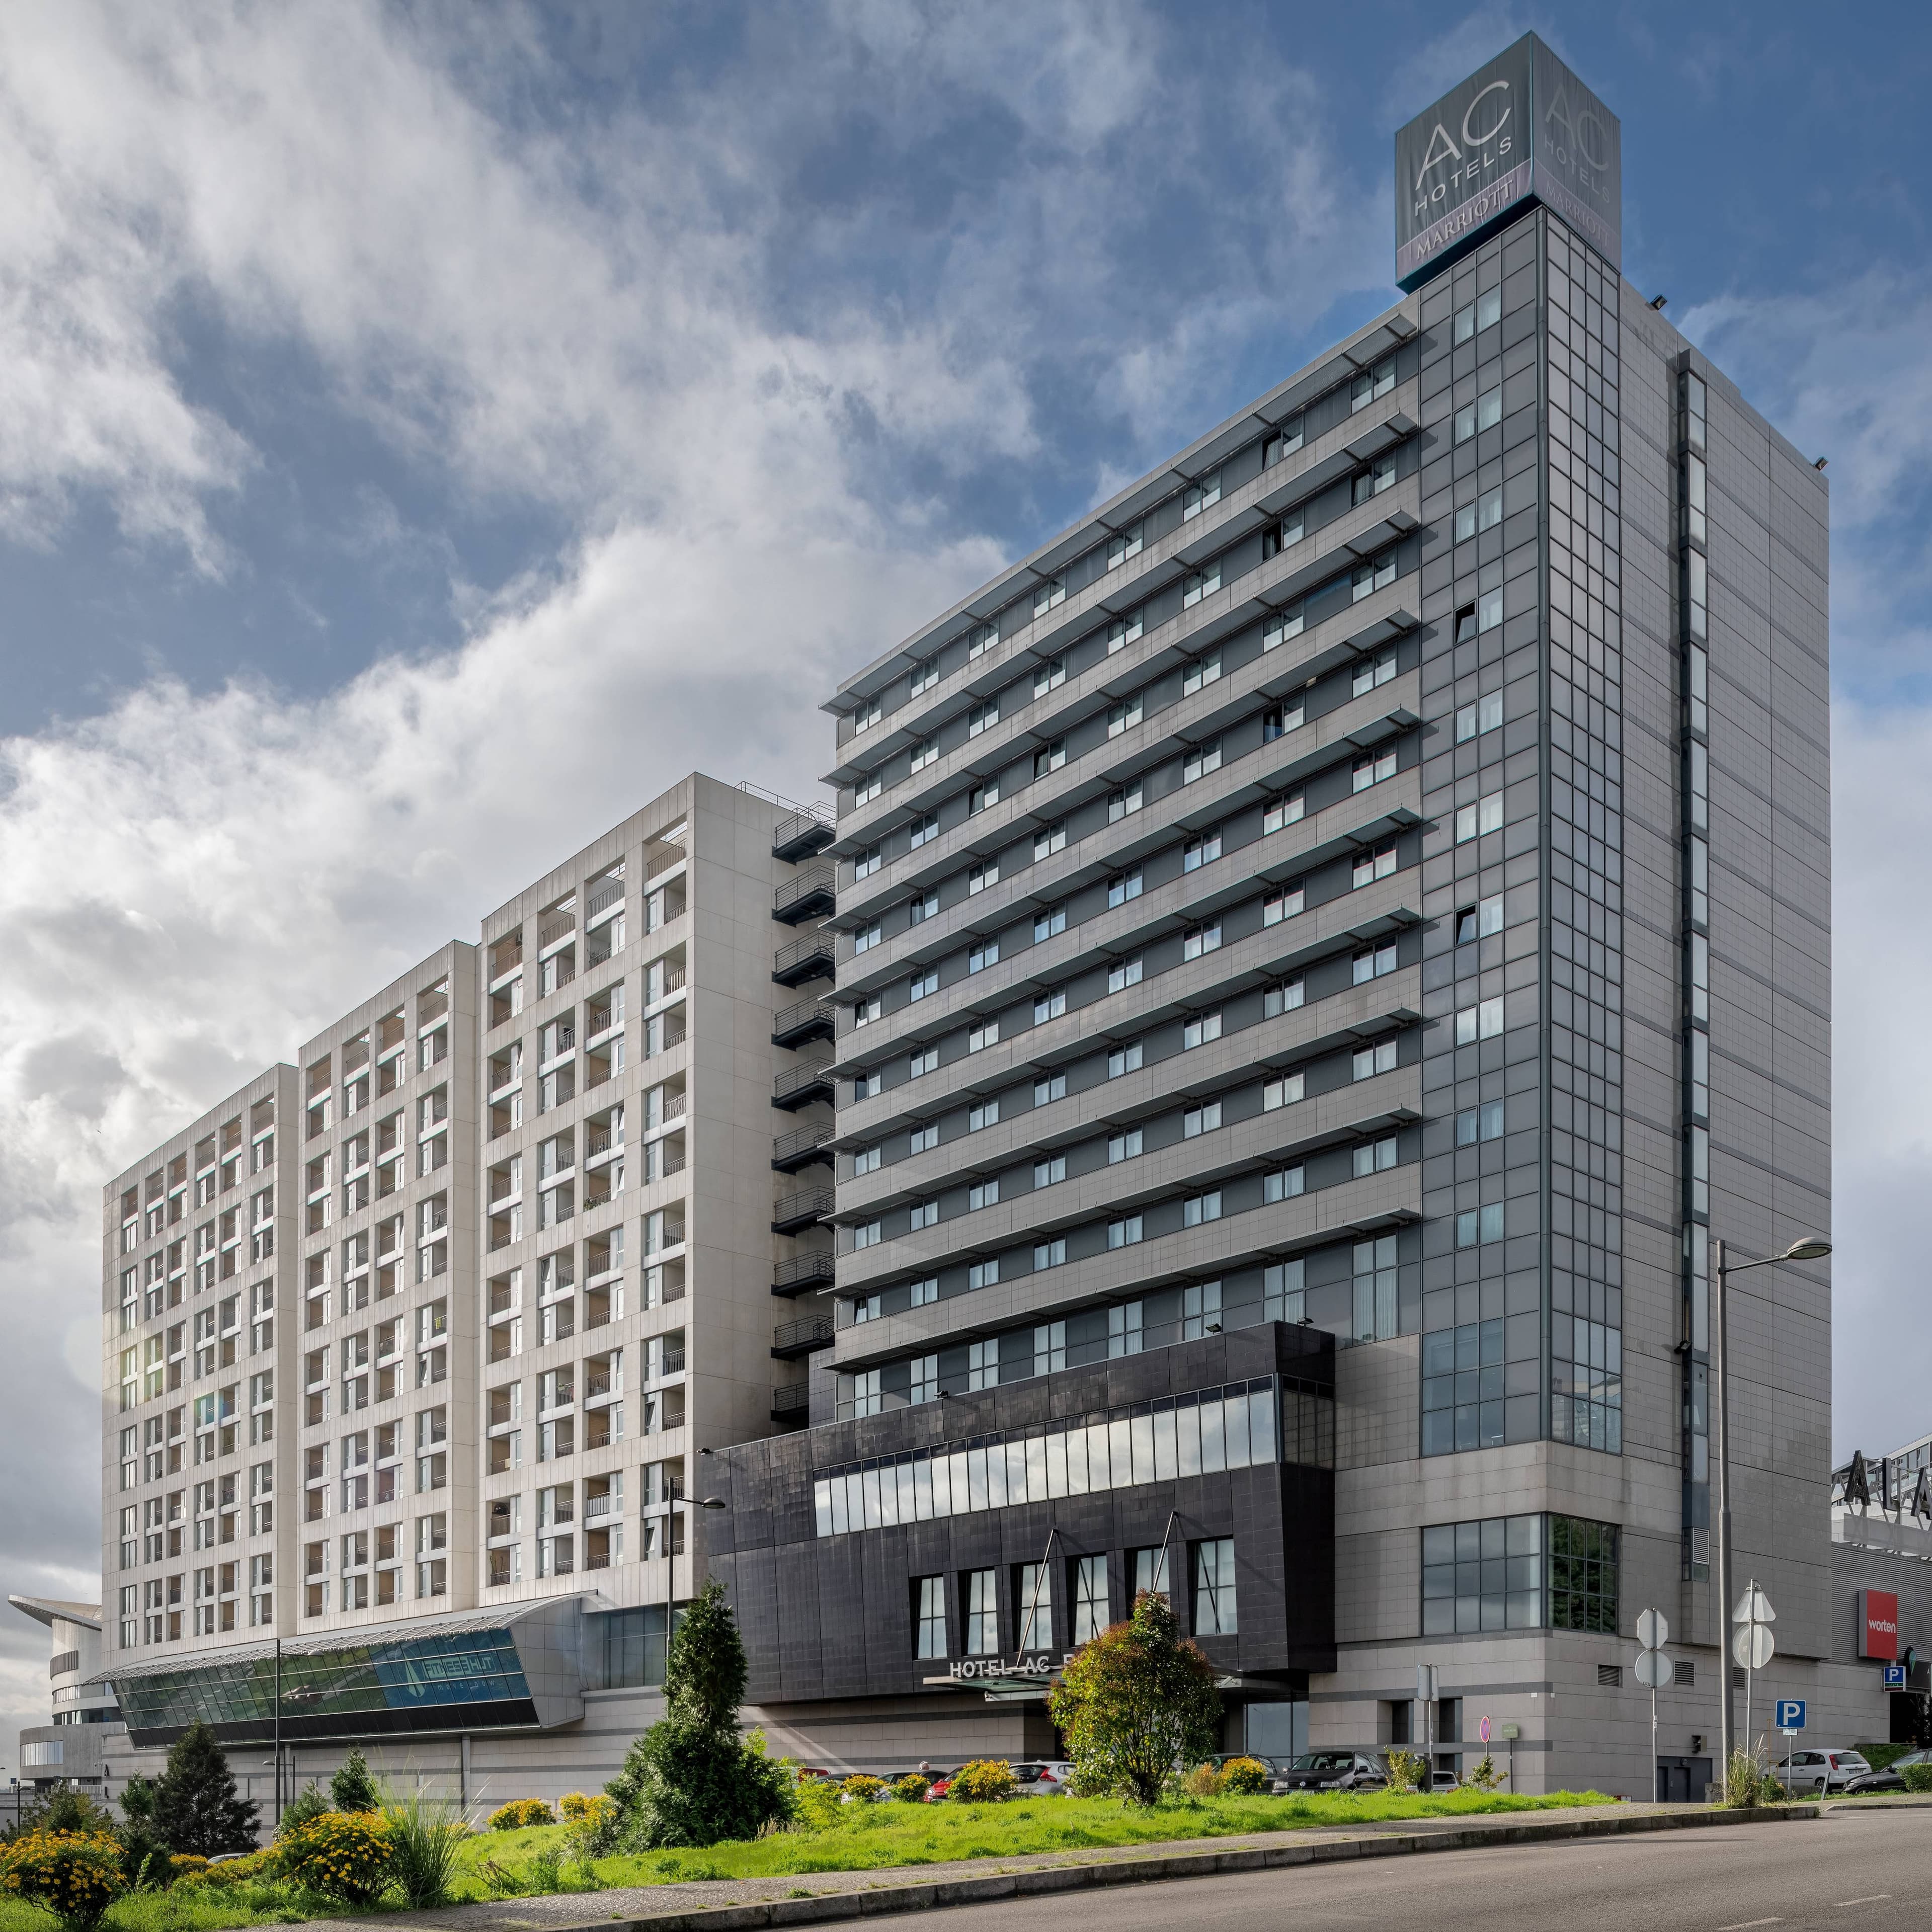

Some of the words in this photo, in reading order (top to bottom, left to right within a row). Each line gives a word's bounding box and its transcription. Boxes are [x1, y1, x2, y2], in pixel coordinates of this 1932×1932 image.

[1415, 80, 1511, 190] AC
[1545, 84, 1609, 171] AC
[1414, 136, 1512, 216] HOTELS
[1545, 133, 1610, 203] HOTELS
[1416, 180, 1514, 260] MARRIOTT
[1547, 181, 1609, 246] MARRIOTT
[1868, 1619, 1896, 1633] worten
[425, 1660, 469, 1674] FITNESS
[469, 1657, 492, 1670] HUT
[950, 1659, 1013, 1678] HOTEL
[1024, 1656, 1052, 1673] AC
[1889, 1669, 1899, 1681] P
[1783, 1703, 1801, 1725] P
